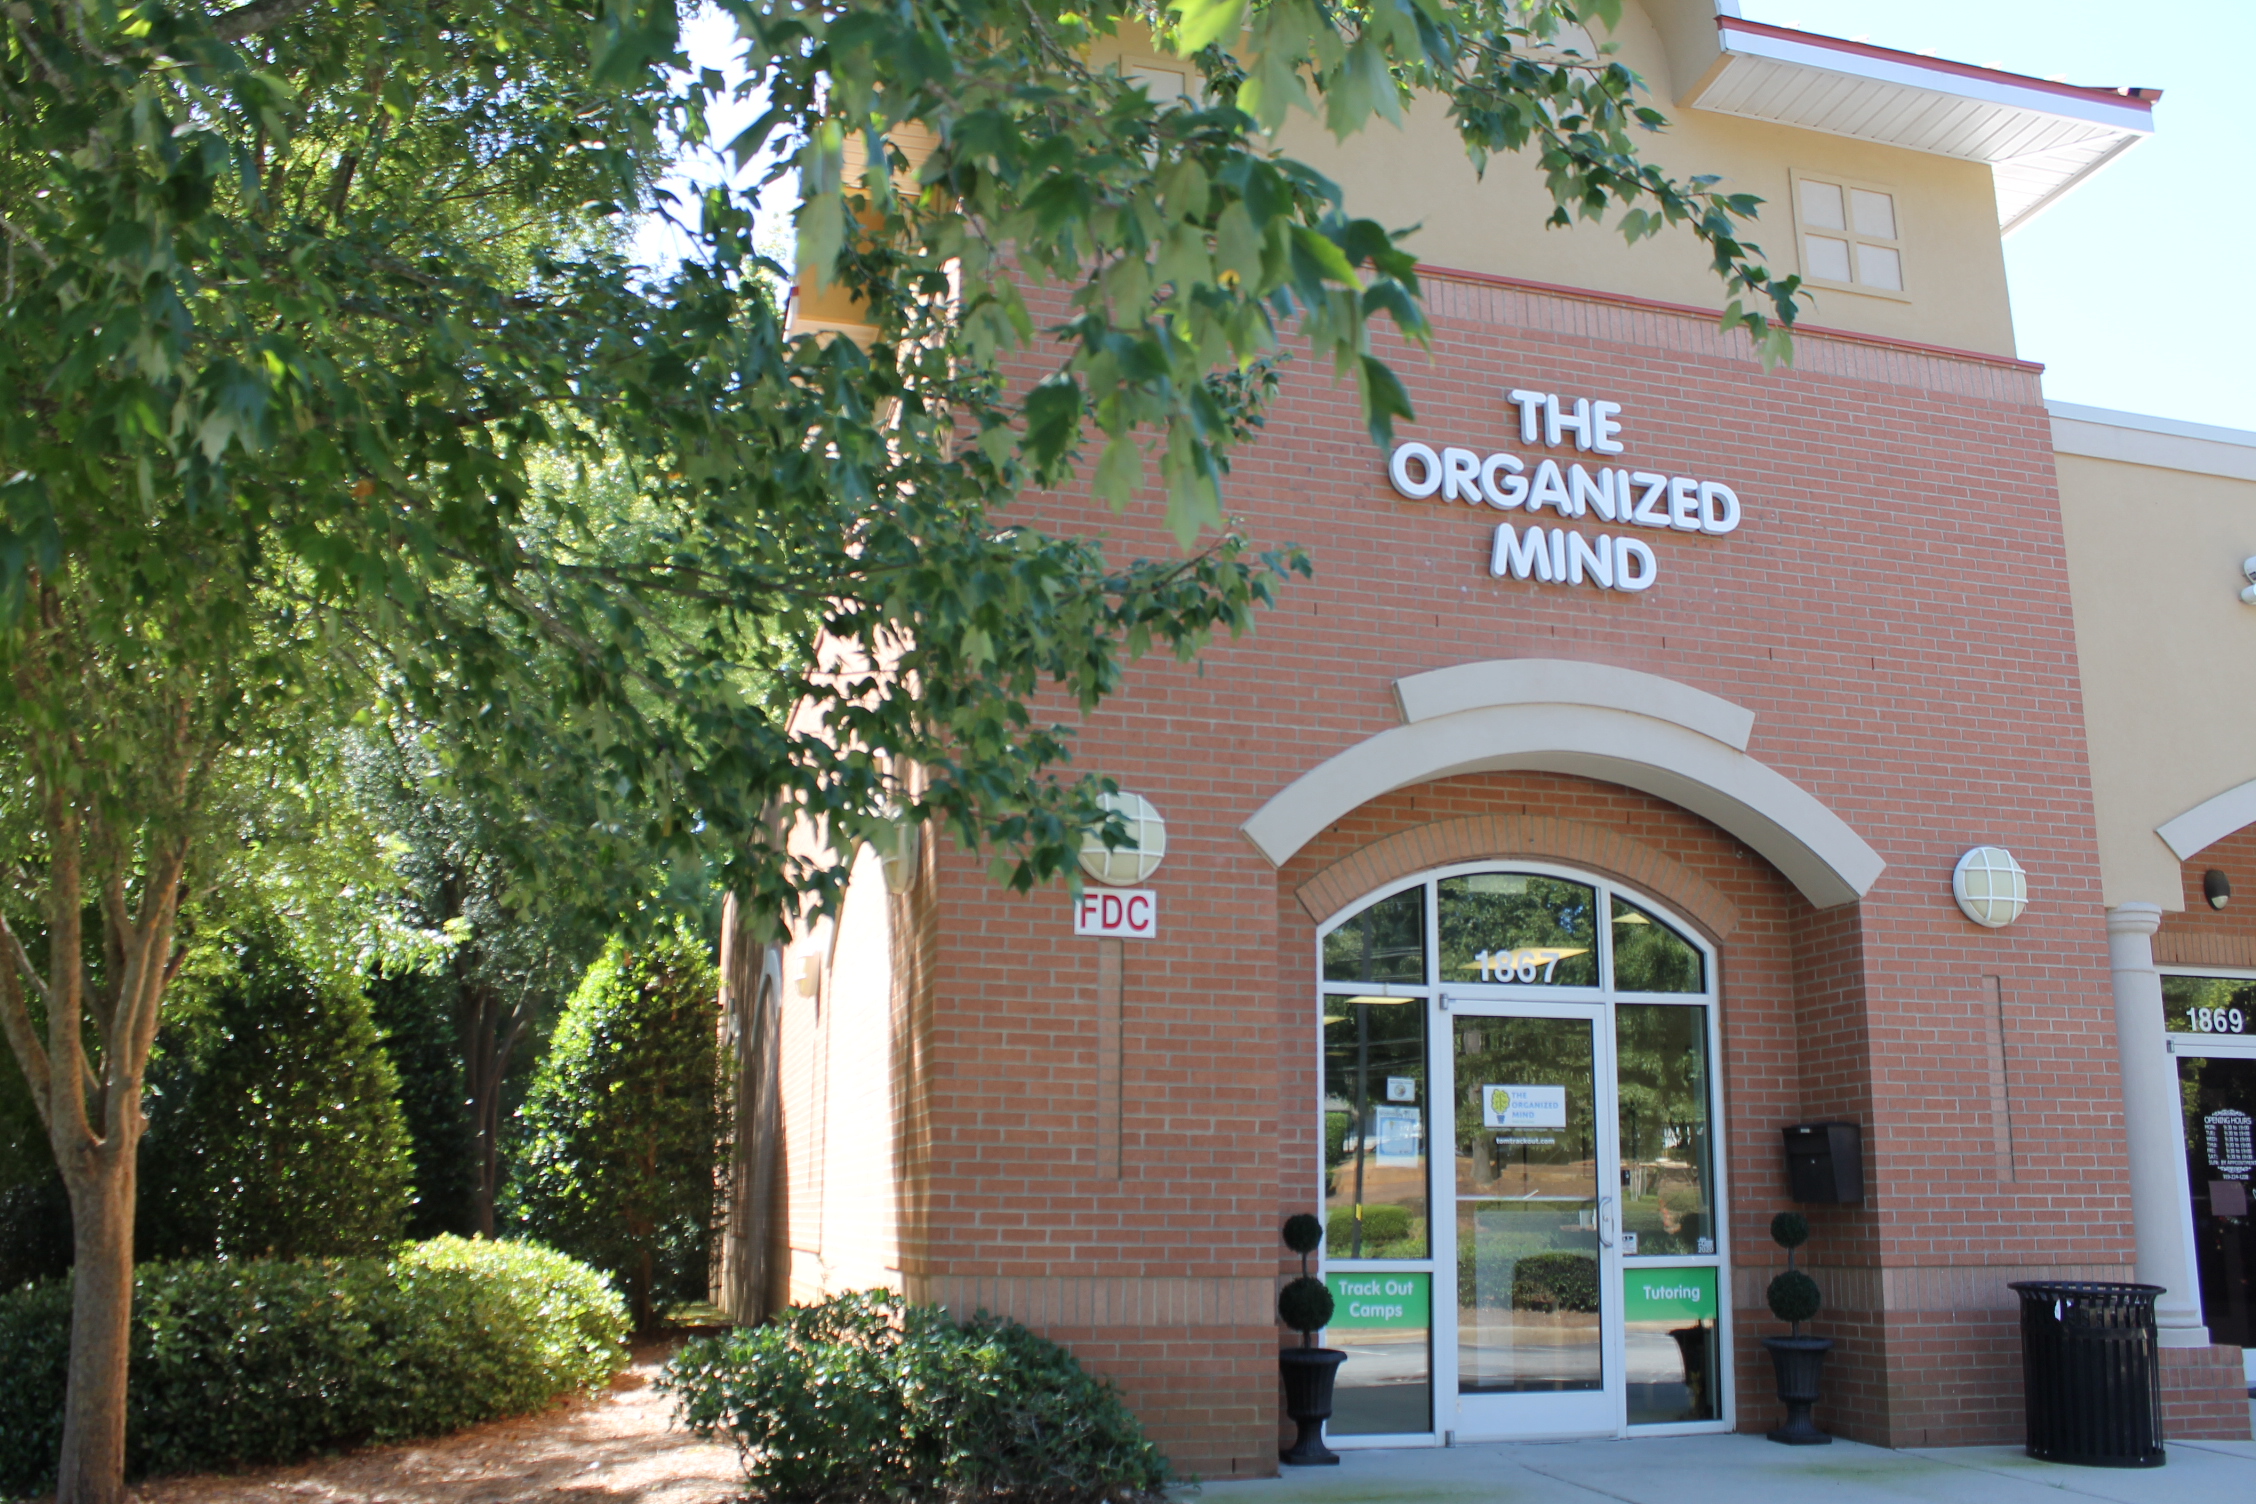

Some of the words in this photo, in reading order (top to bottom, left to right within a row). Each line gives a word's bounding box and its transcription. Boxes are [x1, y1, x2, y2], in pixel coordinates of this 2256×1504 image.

[1507, 389, 1624, 456] THE
[1389, 441, 1741, 536] ORGANIZED
[1490, 521, 1658, 593] MIND
[1080, 894, 1149, 931] FDC
[1474, 949, 1560, 983] 1867
[2186, 1007, 2243, 1033] 1869
[1511, 1101, 1559, 1109] ORGANIZED
[1512, 1111, 1535, 1119] MIND
[2204, 1116, 2230, 1124] OPENING
[2231, 1116, 2252, 1125] HOURS
[1338, 1280, 1380, 1296] Track
[1385, 1280, 1414, 1296] Out
[1643, 1284, 1700, 1302] Tutoring
[1349, 1302, 1403, 1320] Camps
